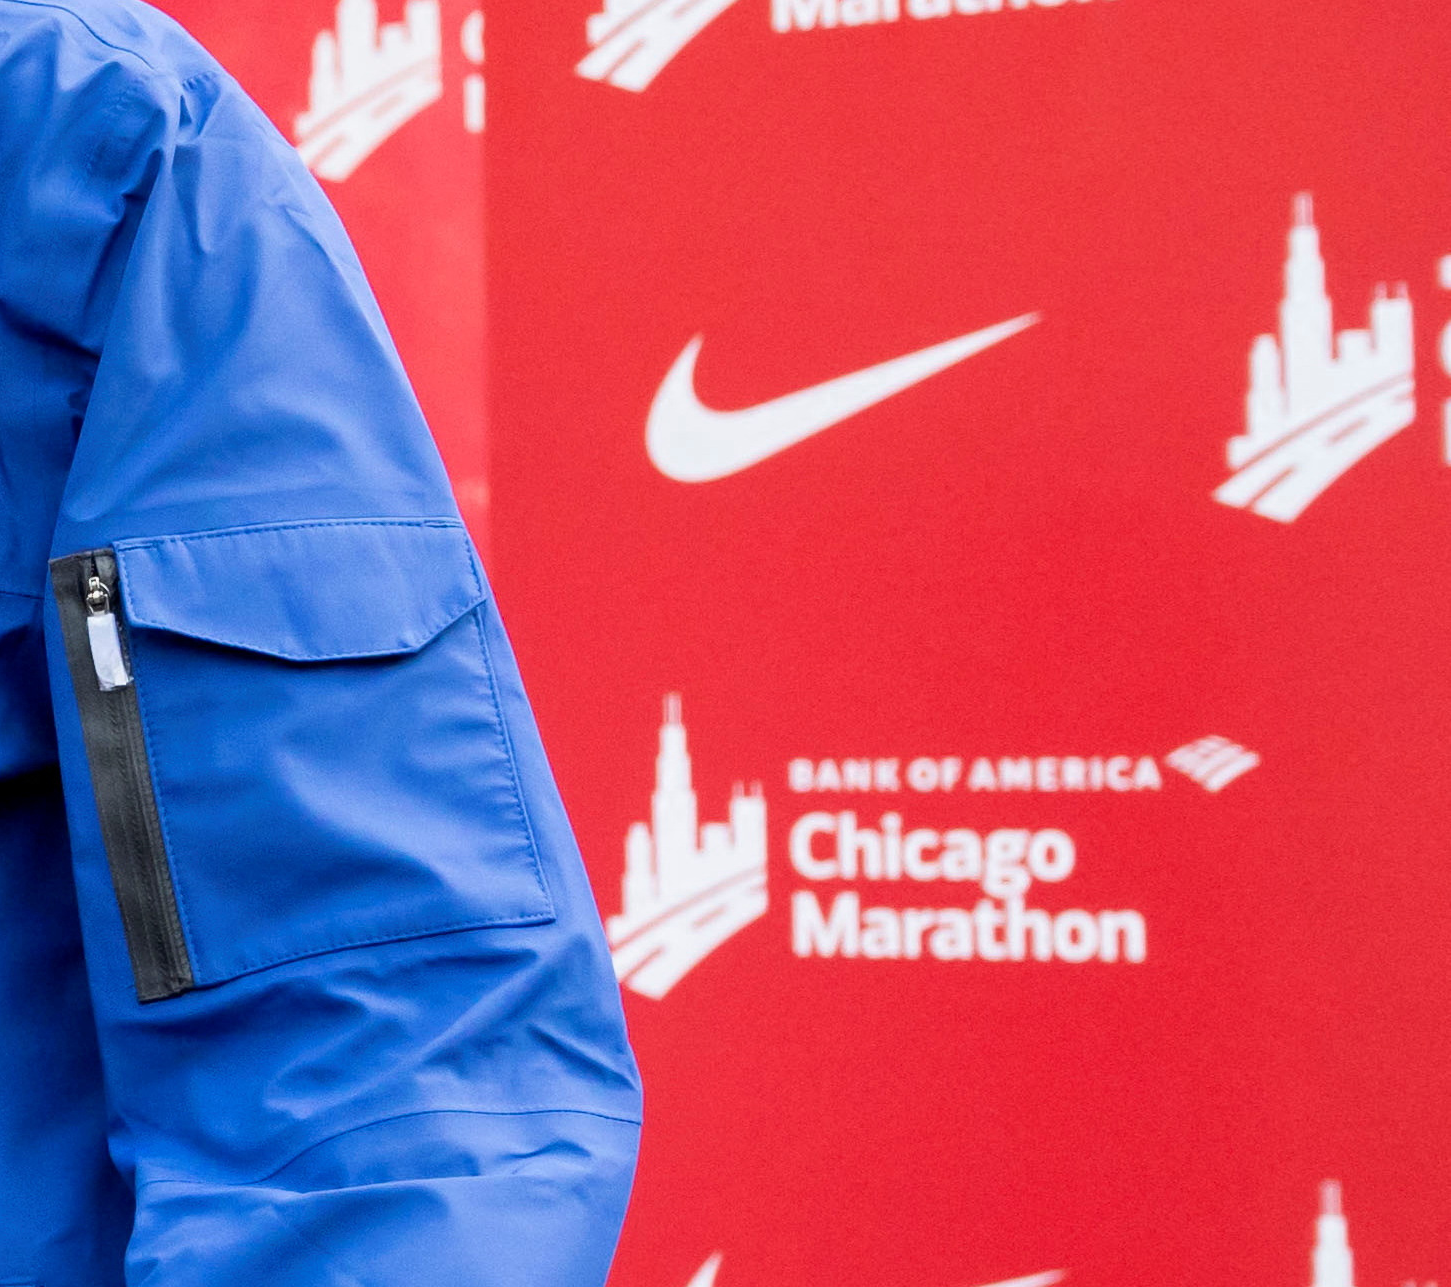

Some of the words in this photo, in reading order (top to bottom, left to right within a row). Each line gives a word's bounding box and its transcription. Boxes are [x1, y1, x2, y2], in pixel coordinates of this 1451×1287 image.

[789, 757, 900, 792] BANK
[905, 757, 963, 793] OF
[967, 755, 1163, 792] AMERICA
[788, 810, 1076, 900] Chicago
[791, 889, 1147, 963] Marathon
